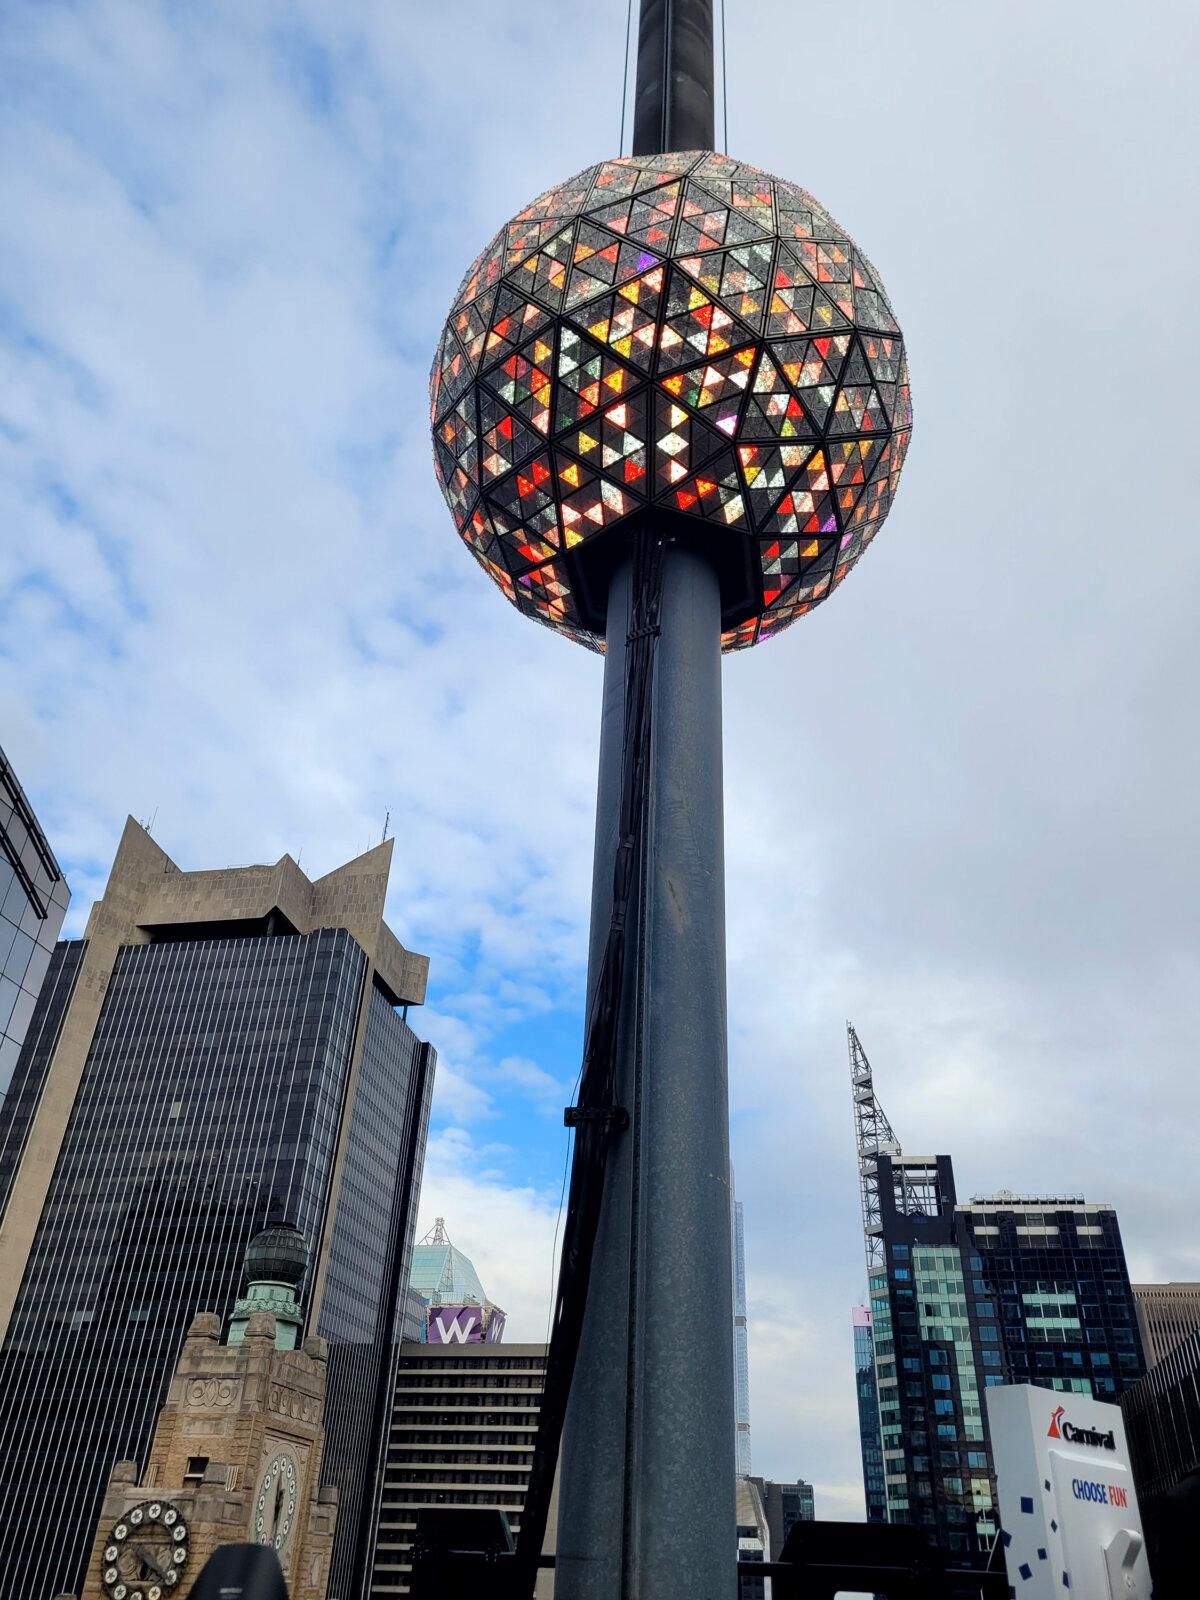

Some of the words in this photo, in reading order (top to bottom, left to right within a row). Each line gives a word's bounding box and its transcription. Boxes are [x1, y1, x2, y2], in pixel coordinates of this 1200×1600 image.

[436, 1317, 476, 1344] W
[1062, 1422, 1116, 1450] Carnival
[1072, 1478, 1108, 1504] CHOOSE
[1108, 1485, 1127, 1508] FUN
